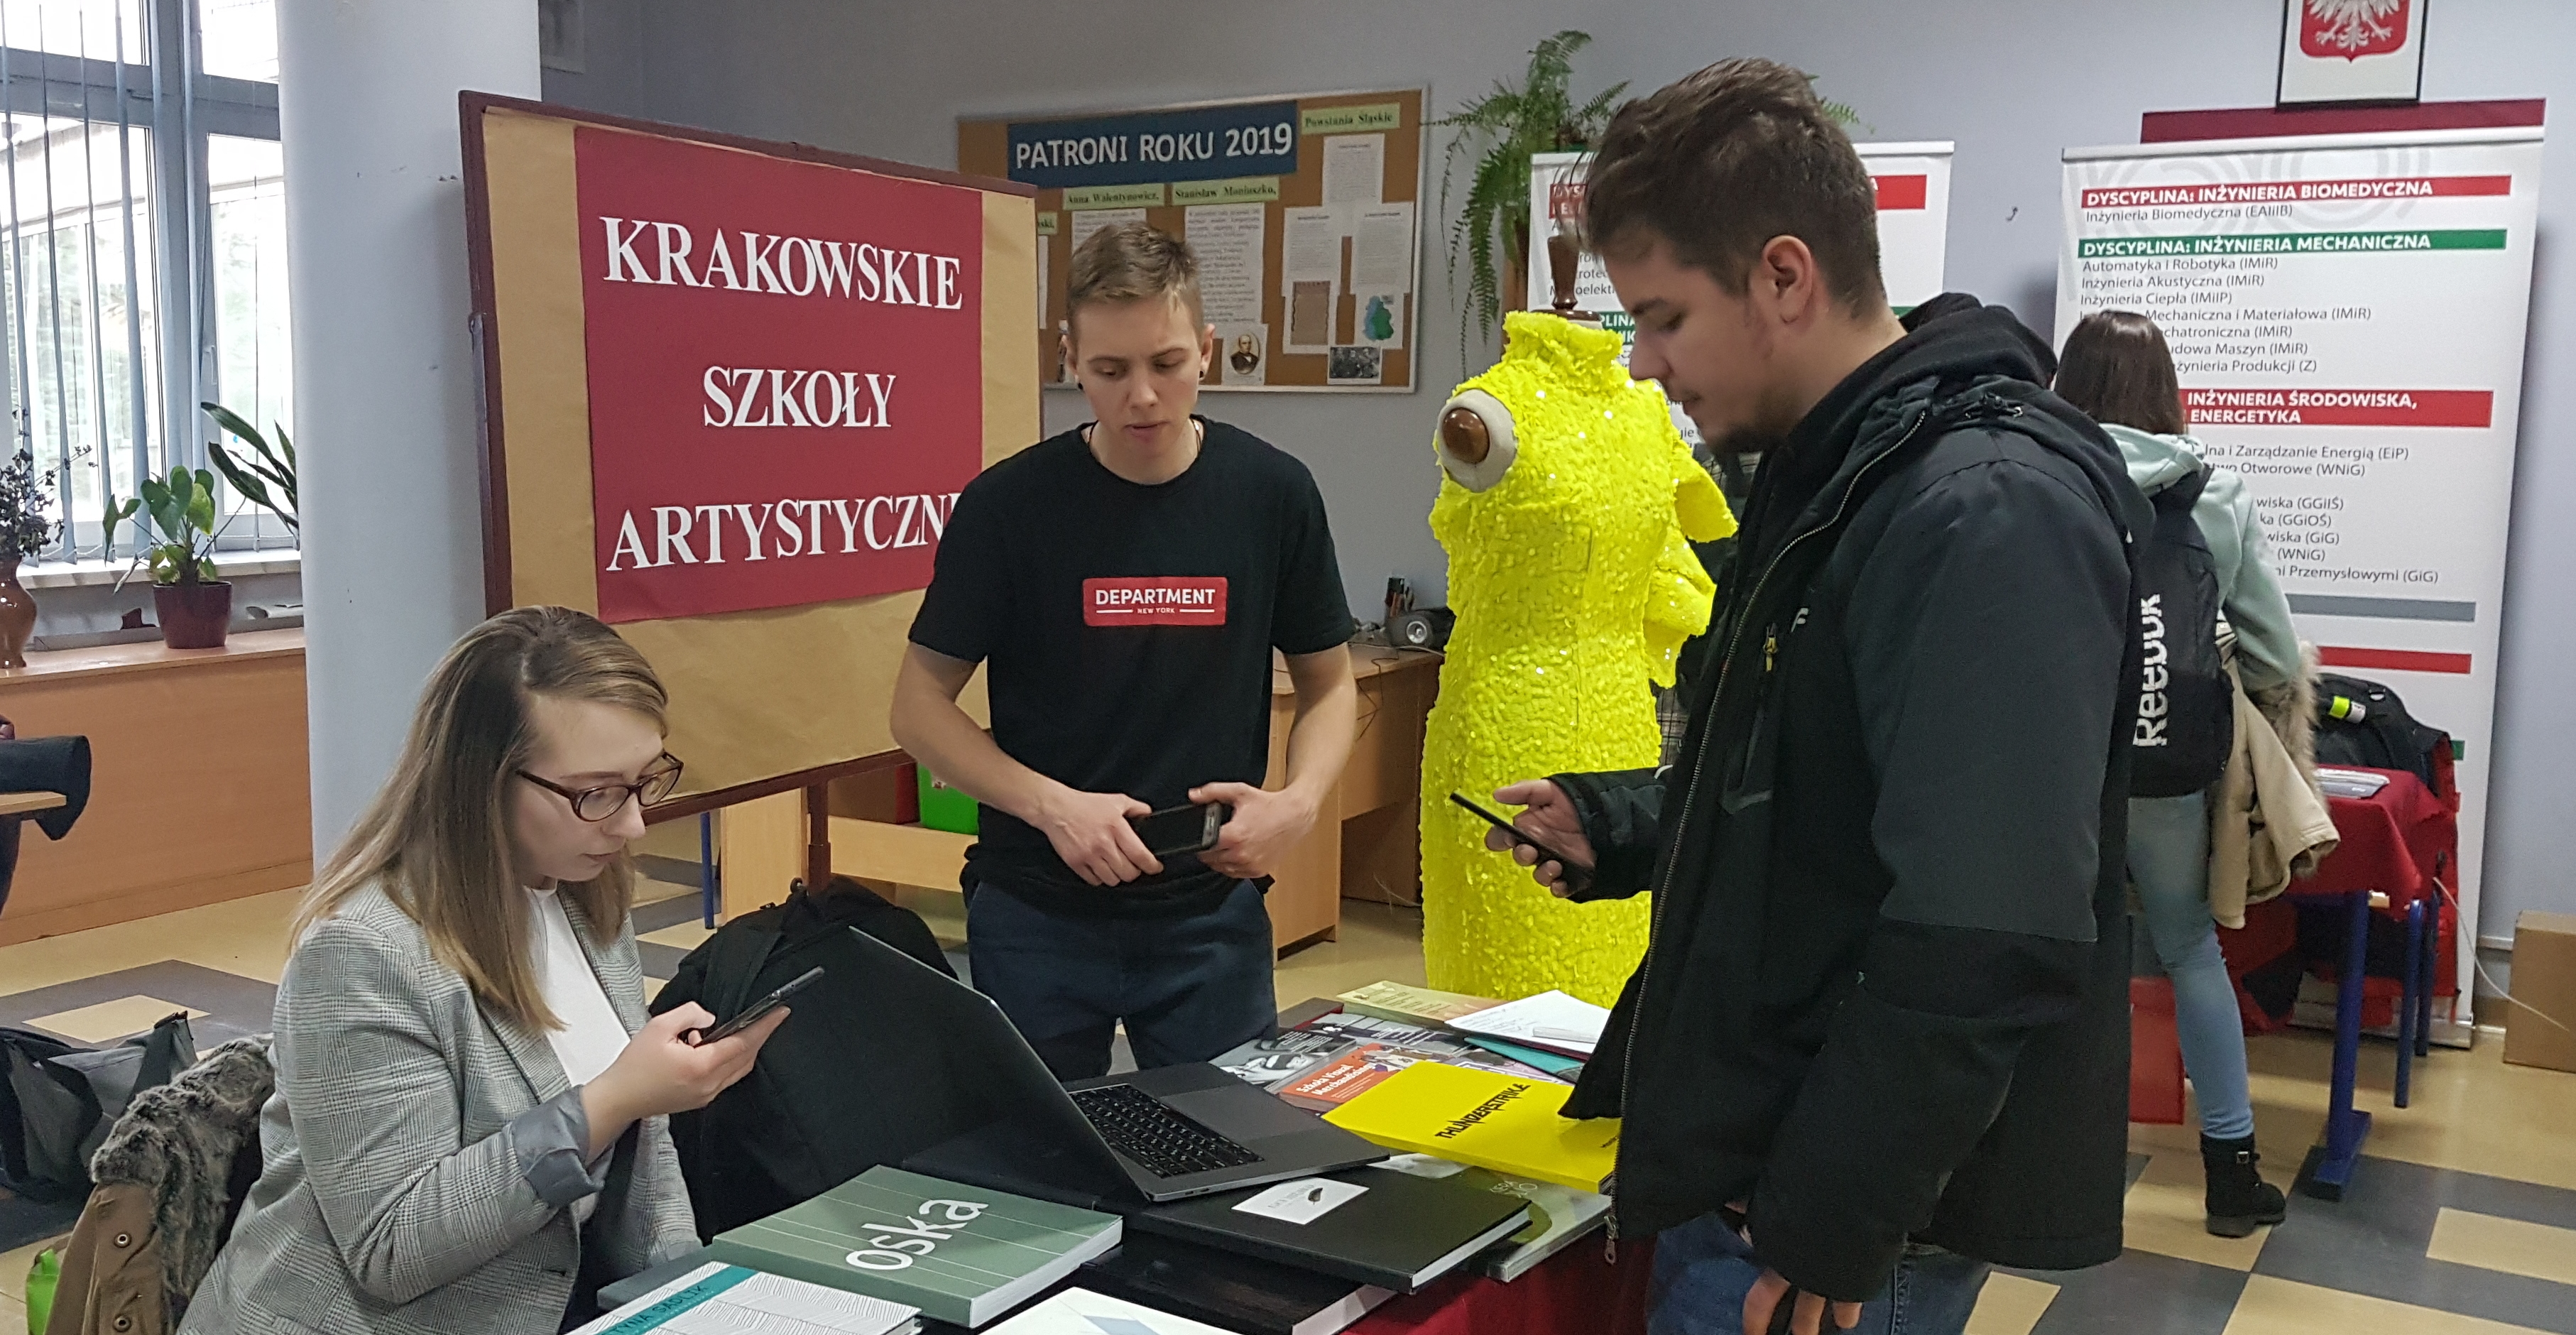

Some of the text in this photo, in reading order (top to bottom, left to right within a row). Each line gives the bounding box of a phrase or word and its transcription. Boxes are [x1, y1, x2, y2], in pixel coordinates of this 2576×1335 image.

[1305, 114, 1353, 127] Powstania
[1016, 122, 1292, 169] PATRONI ROKU 2019
[2087, 181, 2433, 206] DYSCYPLINA: INŻYNIERIA BIOMEDYCZNA
[2086, 209, 2148, 224] Inżynieria
[2152, 207, 2242, 221] Biomedyczna
[2083, 234, 2431, 256] DYSCYPLINA: INŻYNIERIA MECHANICZNA
[599, 217, 963, 310] KRAKOWSKIE
[2083, 259, 2162, 273] Automatyka
[2173, 258, 2236, 273] Robotyka
[2239, 257, 2278, 270] (IMiR)
[2081, 275, 2265, 290] Inżynieria Akustyczna (IMiR)
[2080, 293, 2142, 307] Inżynieria
[2146, 292, 2187, 306] Ciepła
[2145, 309, 2232, 321] Mechaniczna
[2243, 307, 2327, 320] Materiałowa
[2332, 307, 2372, 320] (IMiR)
[2163, 326, 2293, 338] chatroniczna (IMiR)
[2215, 343, 2266, 356] Maszyn
[2269, 342, 2308, 356] (IMiR)
[2176, 359, 2318, 374] żynieria Produkcji (Z)
[704, 366, 896, 427] SZKOŁY
[2187, 389, 2418, 410] INŻYNIERIA ŚRODOWISKA,
[2190, 408, 2301, 423] ENERGETYKA
[2236, 445, 2318, 459] Zarządzanie
[2321, 447, 2374, 462] Energią
[2379, 447, 2409, 461] (EiP)
[2241, 462, 2313, 474] Otworowe
[2316, 462, 2366, 476] (WNiG)
[606, 493, 962, 571] ARTYSTYCZN
[2305, 532, 2340, 545] (GiG)
[2277, 547, 2326, 562] (WNiG)
[2403, 570, 2439, 584] (GiG)
[1096, 588, 1216, 605] DEPARTMENT
[1434, 1083, 1532, 1139] THUNDERSTRIKE
[846, 1199, 989, 1270] oska
[601, 1313, 654, 1335] TYNA
